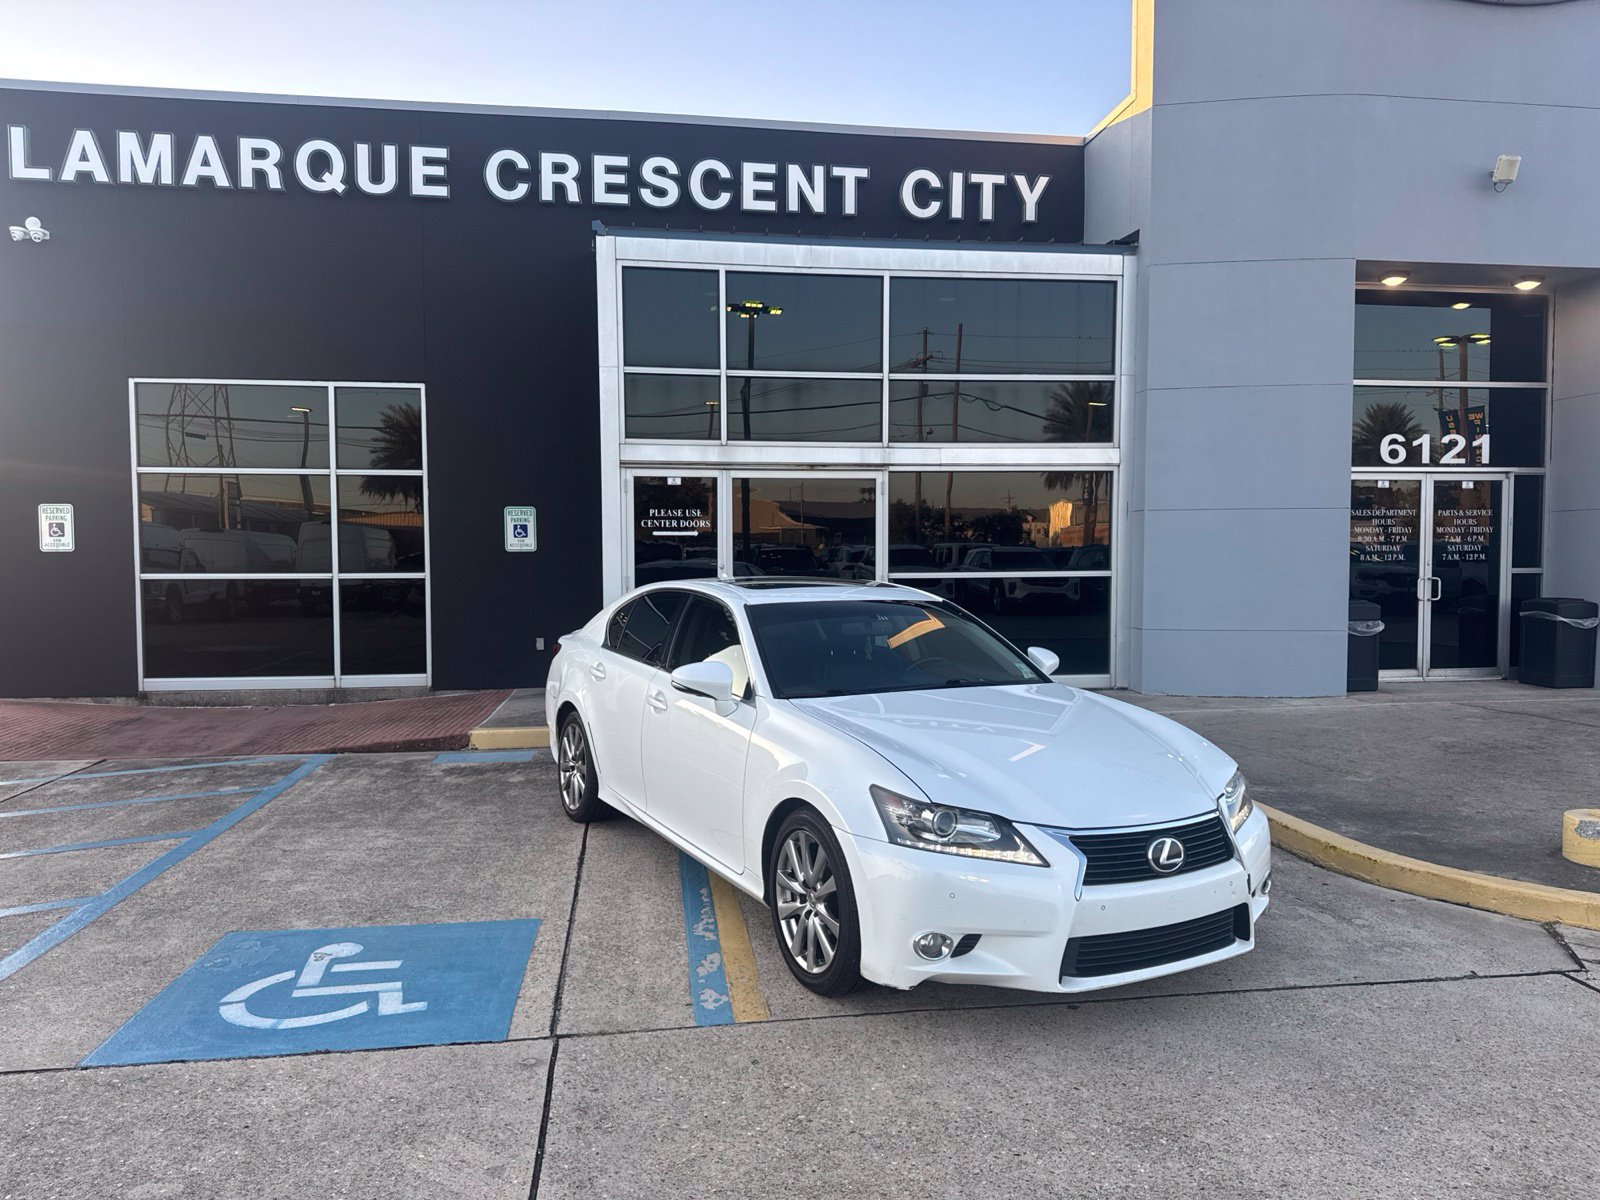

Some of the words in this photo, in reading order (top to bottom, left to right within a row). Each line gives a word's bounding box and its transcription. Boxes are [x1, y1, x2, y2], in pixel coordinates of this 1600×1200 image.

[8, 124, 450, 198] LAMARQUE
[483, 149, 870, 216] CRESCENT
[900, 168, 1052, 223] CITY
[1380, 433, 1490, 465] 6121
[649, 509, 684, 517] PLEASE
[685, 509, 703, 517] USE
[641, 520, 678, 528] CENTER
[680, 520, 711, 528] DOORS
